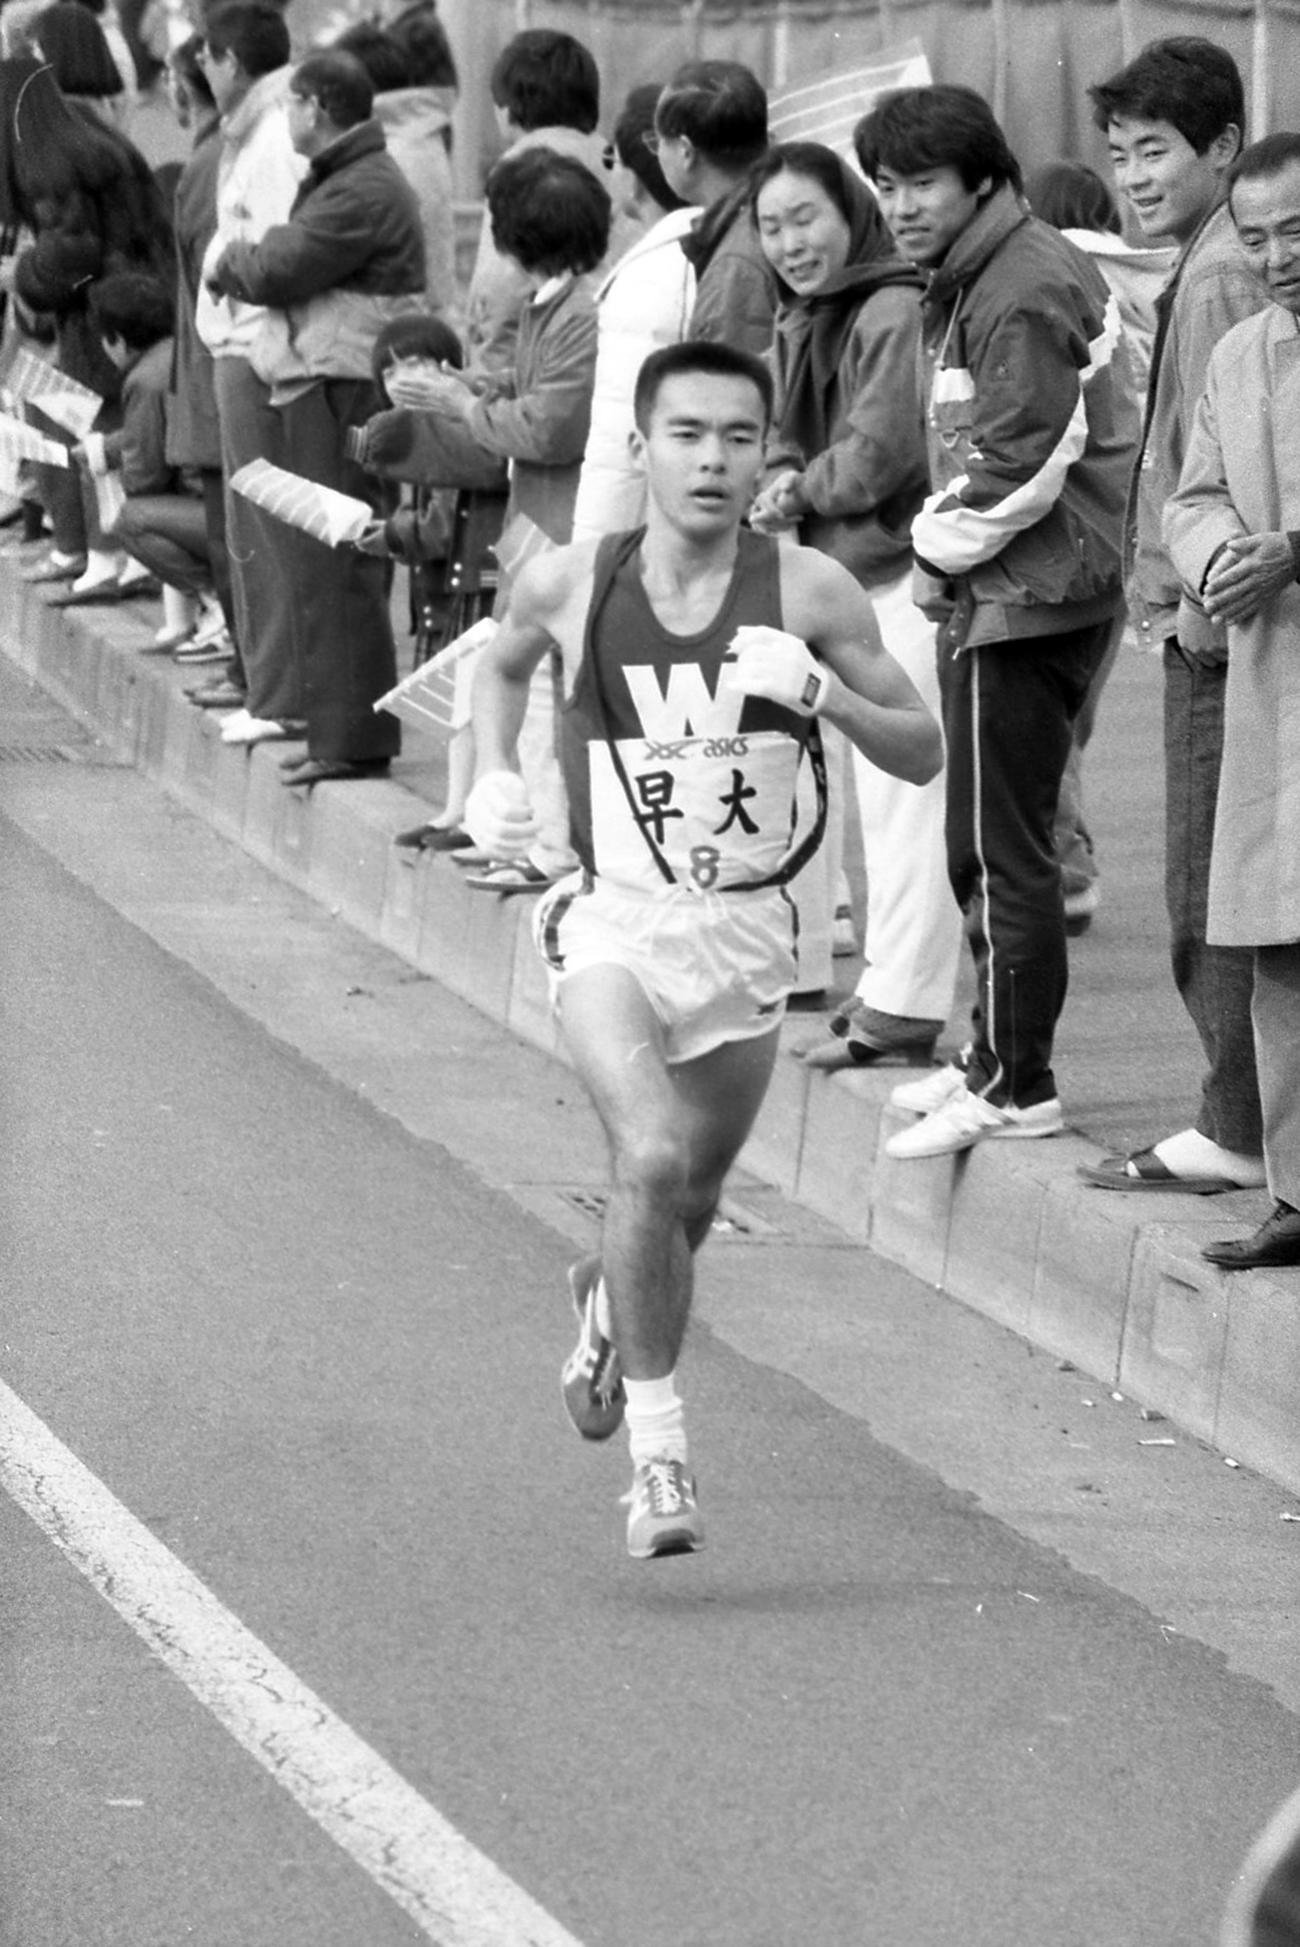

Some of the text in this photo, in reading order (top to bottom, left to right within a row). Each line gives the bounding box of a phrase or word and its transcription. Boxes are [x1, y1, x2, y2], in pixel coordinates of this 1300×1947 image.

[621, 662, 747, 738] W
[634, 768, 760, 845] 早大
[689, 845, 721, 889] 8
